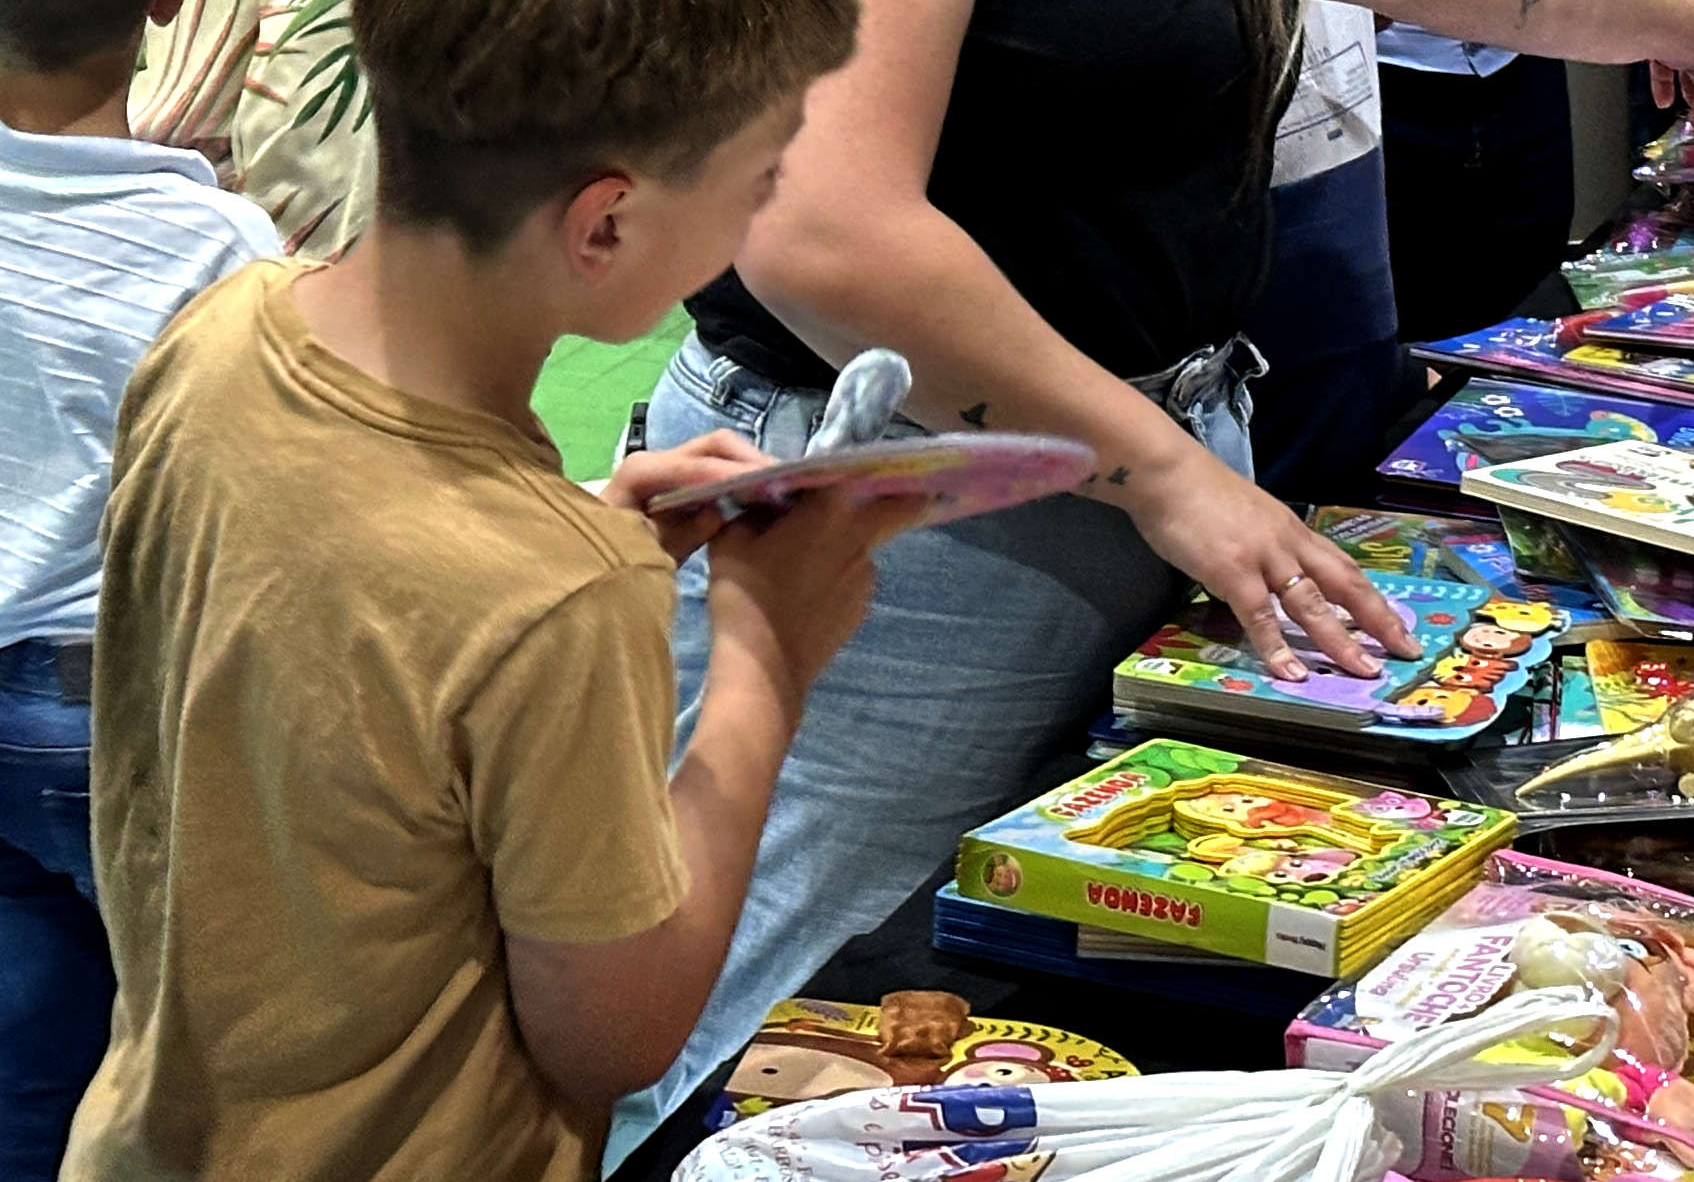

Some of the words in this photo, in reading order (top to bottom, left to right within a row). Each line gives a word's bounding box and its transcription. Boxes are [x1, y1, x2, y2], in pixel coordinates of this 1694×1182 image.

[1046, 771, 1149, 820] FAZENDA
[1083, 881, 1204, 930] FAZENDA
[1401, 935, 1515, 1025] FANTOCHE
[1464, 964, 1512, 1003] LIVRO
